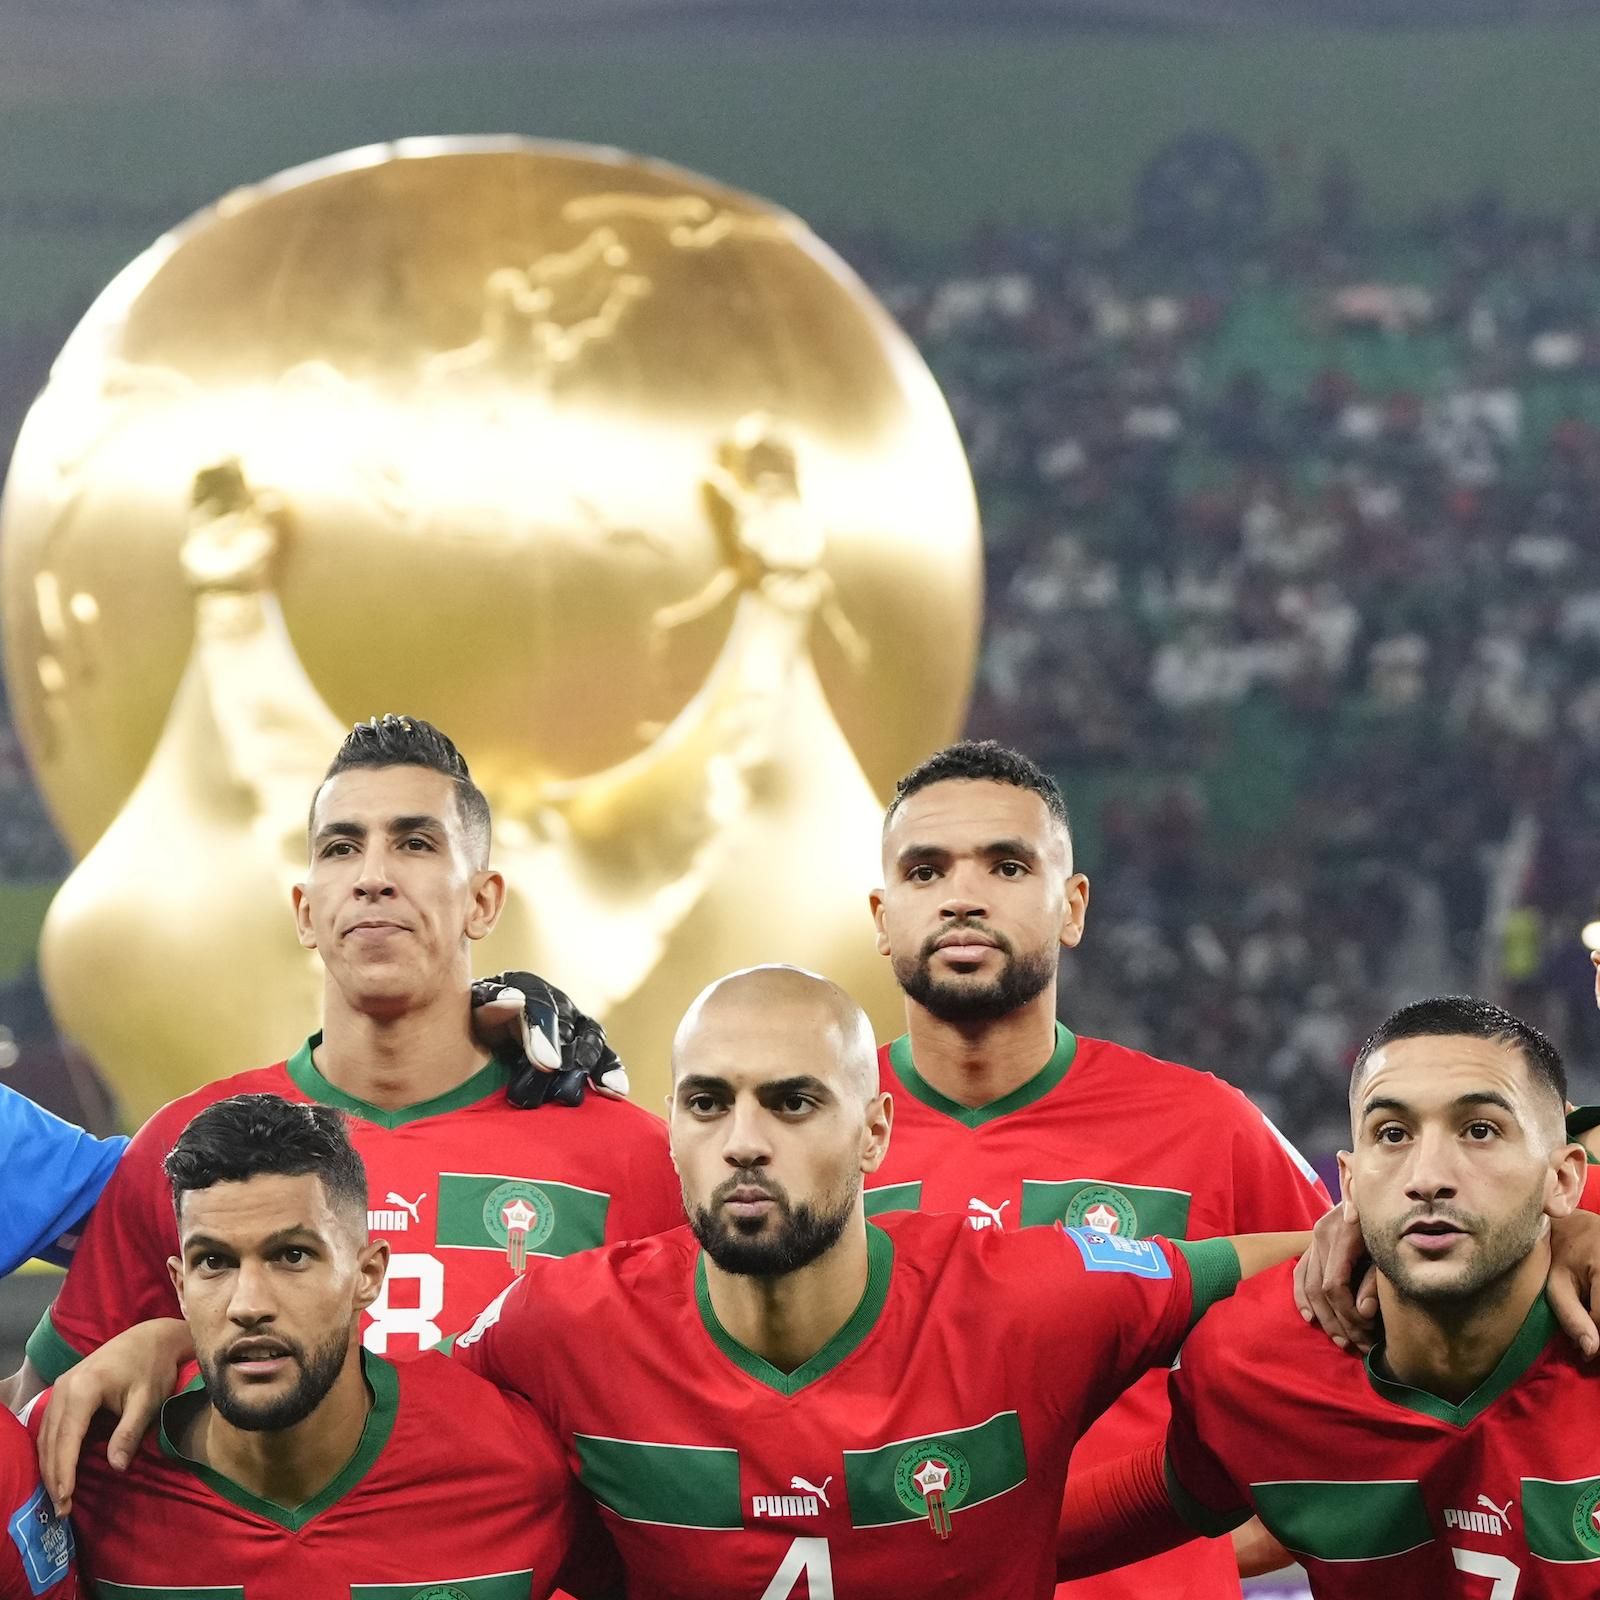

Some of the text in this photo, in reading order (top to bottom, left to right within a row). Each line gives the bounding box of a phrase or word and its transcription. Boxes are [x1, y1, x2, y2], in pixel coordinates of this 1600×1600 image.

[367, 1210, 409, 1231] UMA
[752, 1494, 819, 1518] PUMA
[1445, 1508, 1503, 1536] PUMA
